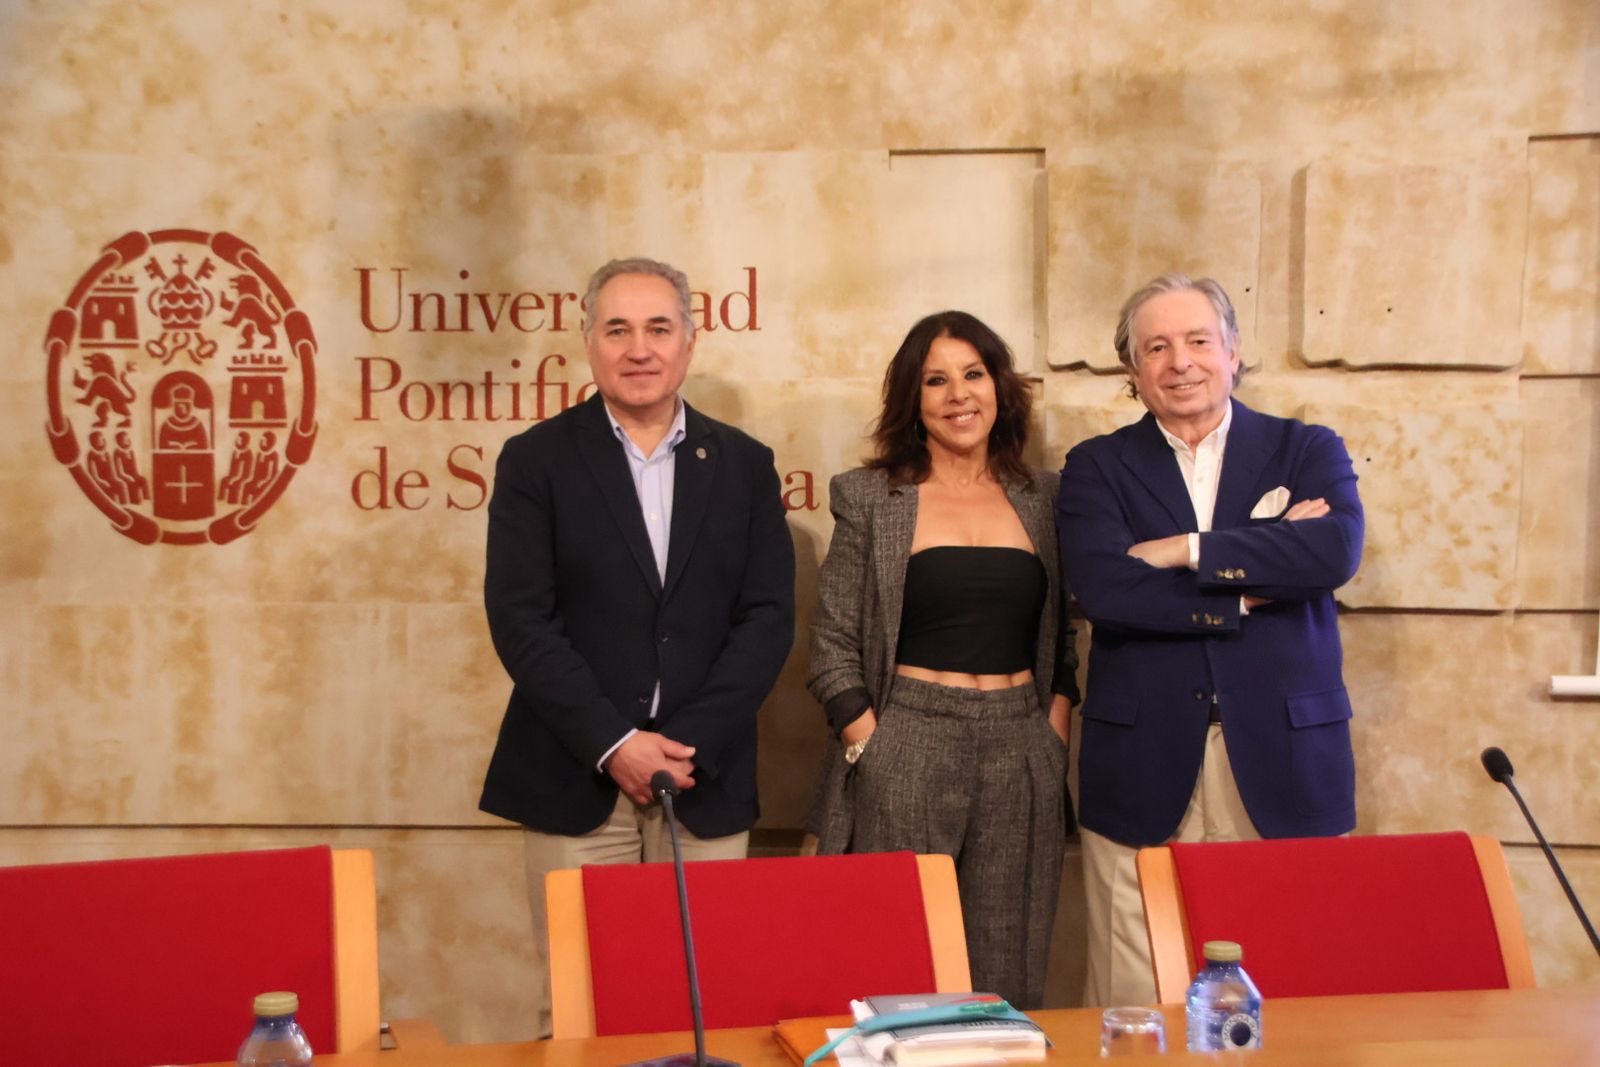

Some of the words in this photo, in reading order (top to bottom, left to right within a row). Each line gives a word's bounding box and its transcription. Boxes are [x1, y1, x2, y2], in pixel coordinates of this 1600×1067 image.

[353, 267, 762, 334] Univerad
[353, 354, 598, 422] Pontifi
[351, 446, 430, 511] de
